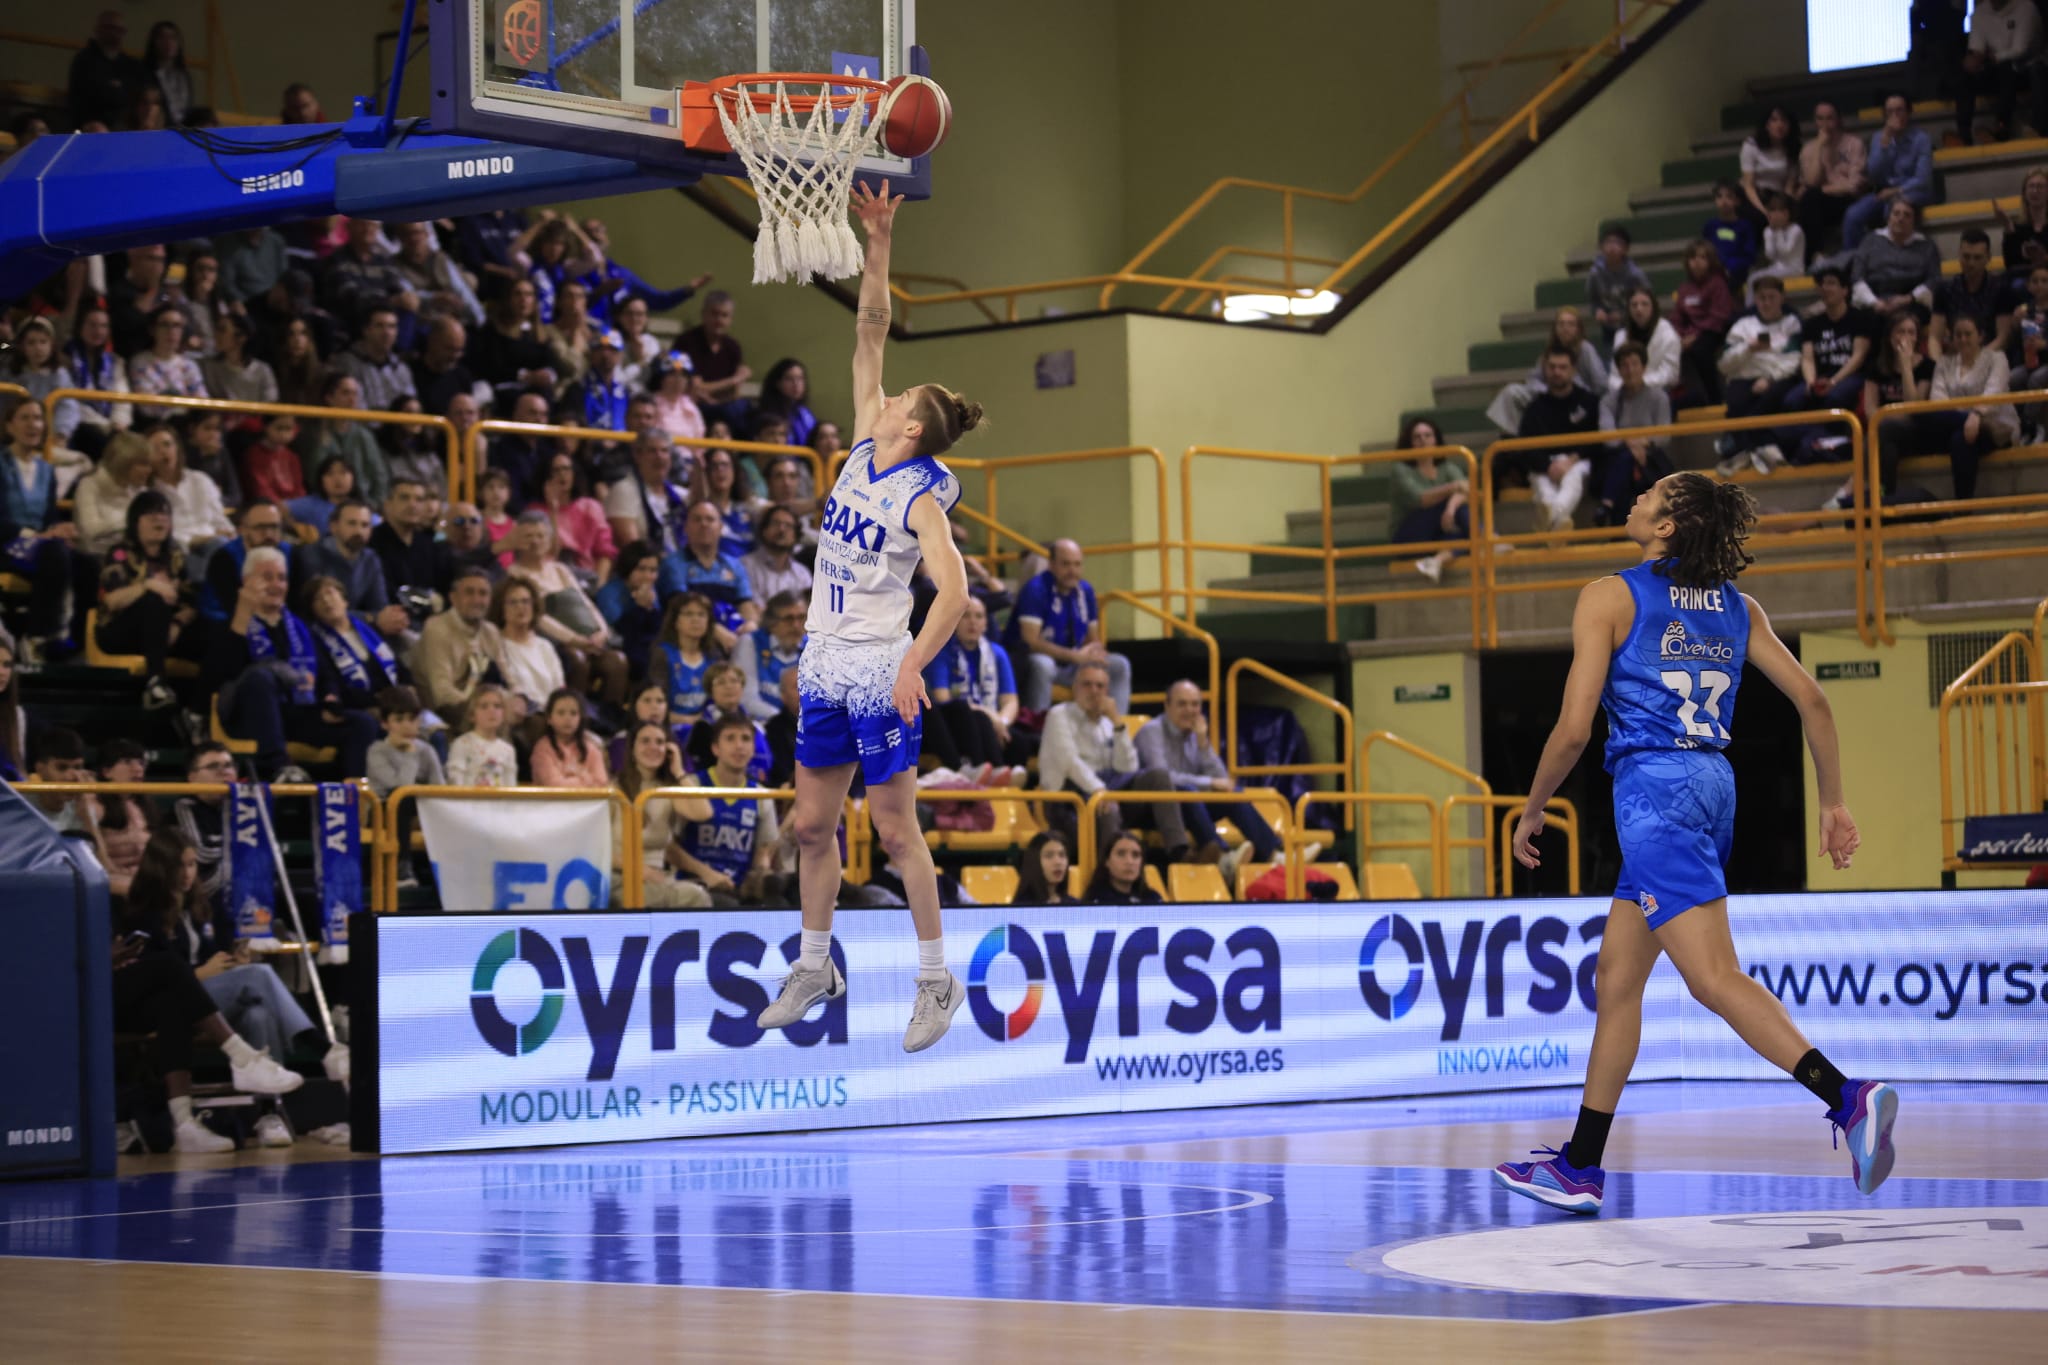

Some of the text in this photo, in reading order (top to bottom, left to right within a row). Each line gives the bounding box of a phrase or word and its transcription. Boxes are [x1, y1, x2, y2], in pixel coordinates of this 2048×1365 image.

[241, 169, 304, 194] MONDO
[447, 156, 514, 178] MONDO
[822, 495, 887, 553] BAXI
[829, 583, 844, 614] 11
[1669, 586, 1724, 612] PRINCE
[698, 823, 753, 853] BAXI
[1095, 1047, 1285, 1084] www.oyrsa.es
[1437, 1038, 1569, 1076] INNOVACIÓN
[479, 1085, 642, 1126] MODULAR
[668, 1075, 849, 1115] PASSIVHAUS
[7, 1126, 73, 1146] MONDO
